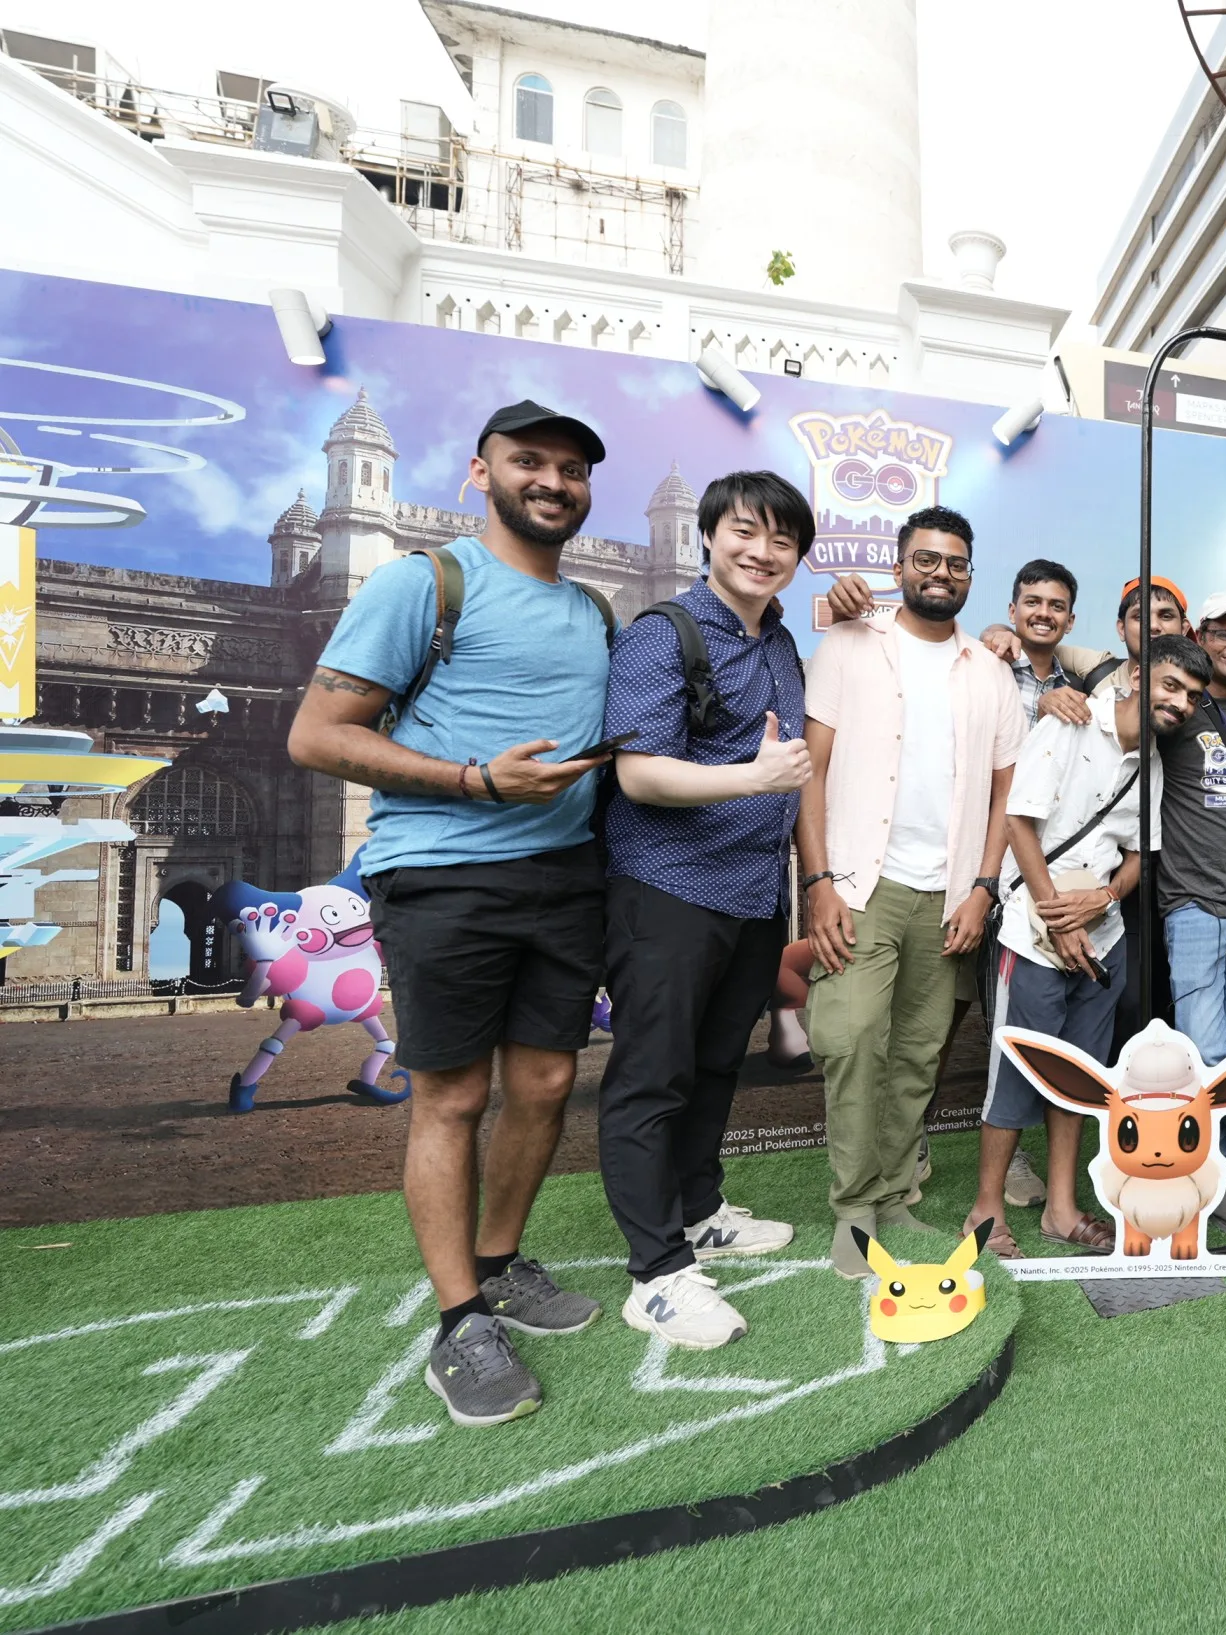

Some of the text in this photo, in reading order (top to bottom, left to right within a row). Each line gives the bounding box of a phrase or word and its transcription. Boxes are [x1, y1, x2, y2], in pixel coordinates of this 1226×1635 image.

[832, 459, 917, 505] GO
[814, 542, 859, 563] CITY
[1205, 778, 1220, 786] CITY
[758, 1121, 811, 1138] Pokémon.
[742, 1142, 762, 1153] and
[765, 1138, 814, 1151] Pokémon
[1020, 1267, 1047, 1275] Niantic,
[1091, 1265, 1125, 1273] Pokémon.
